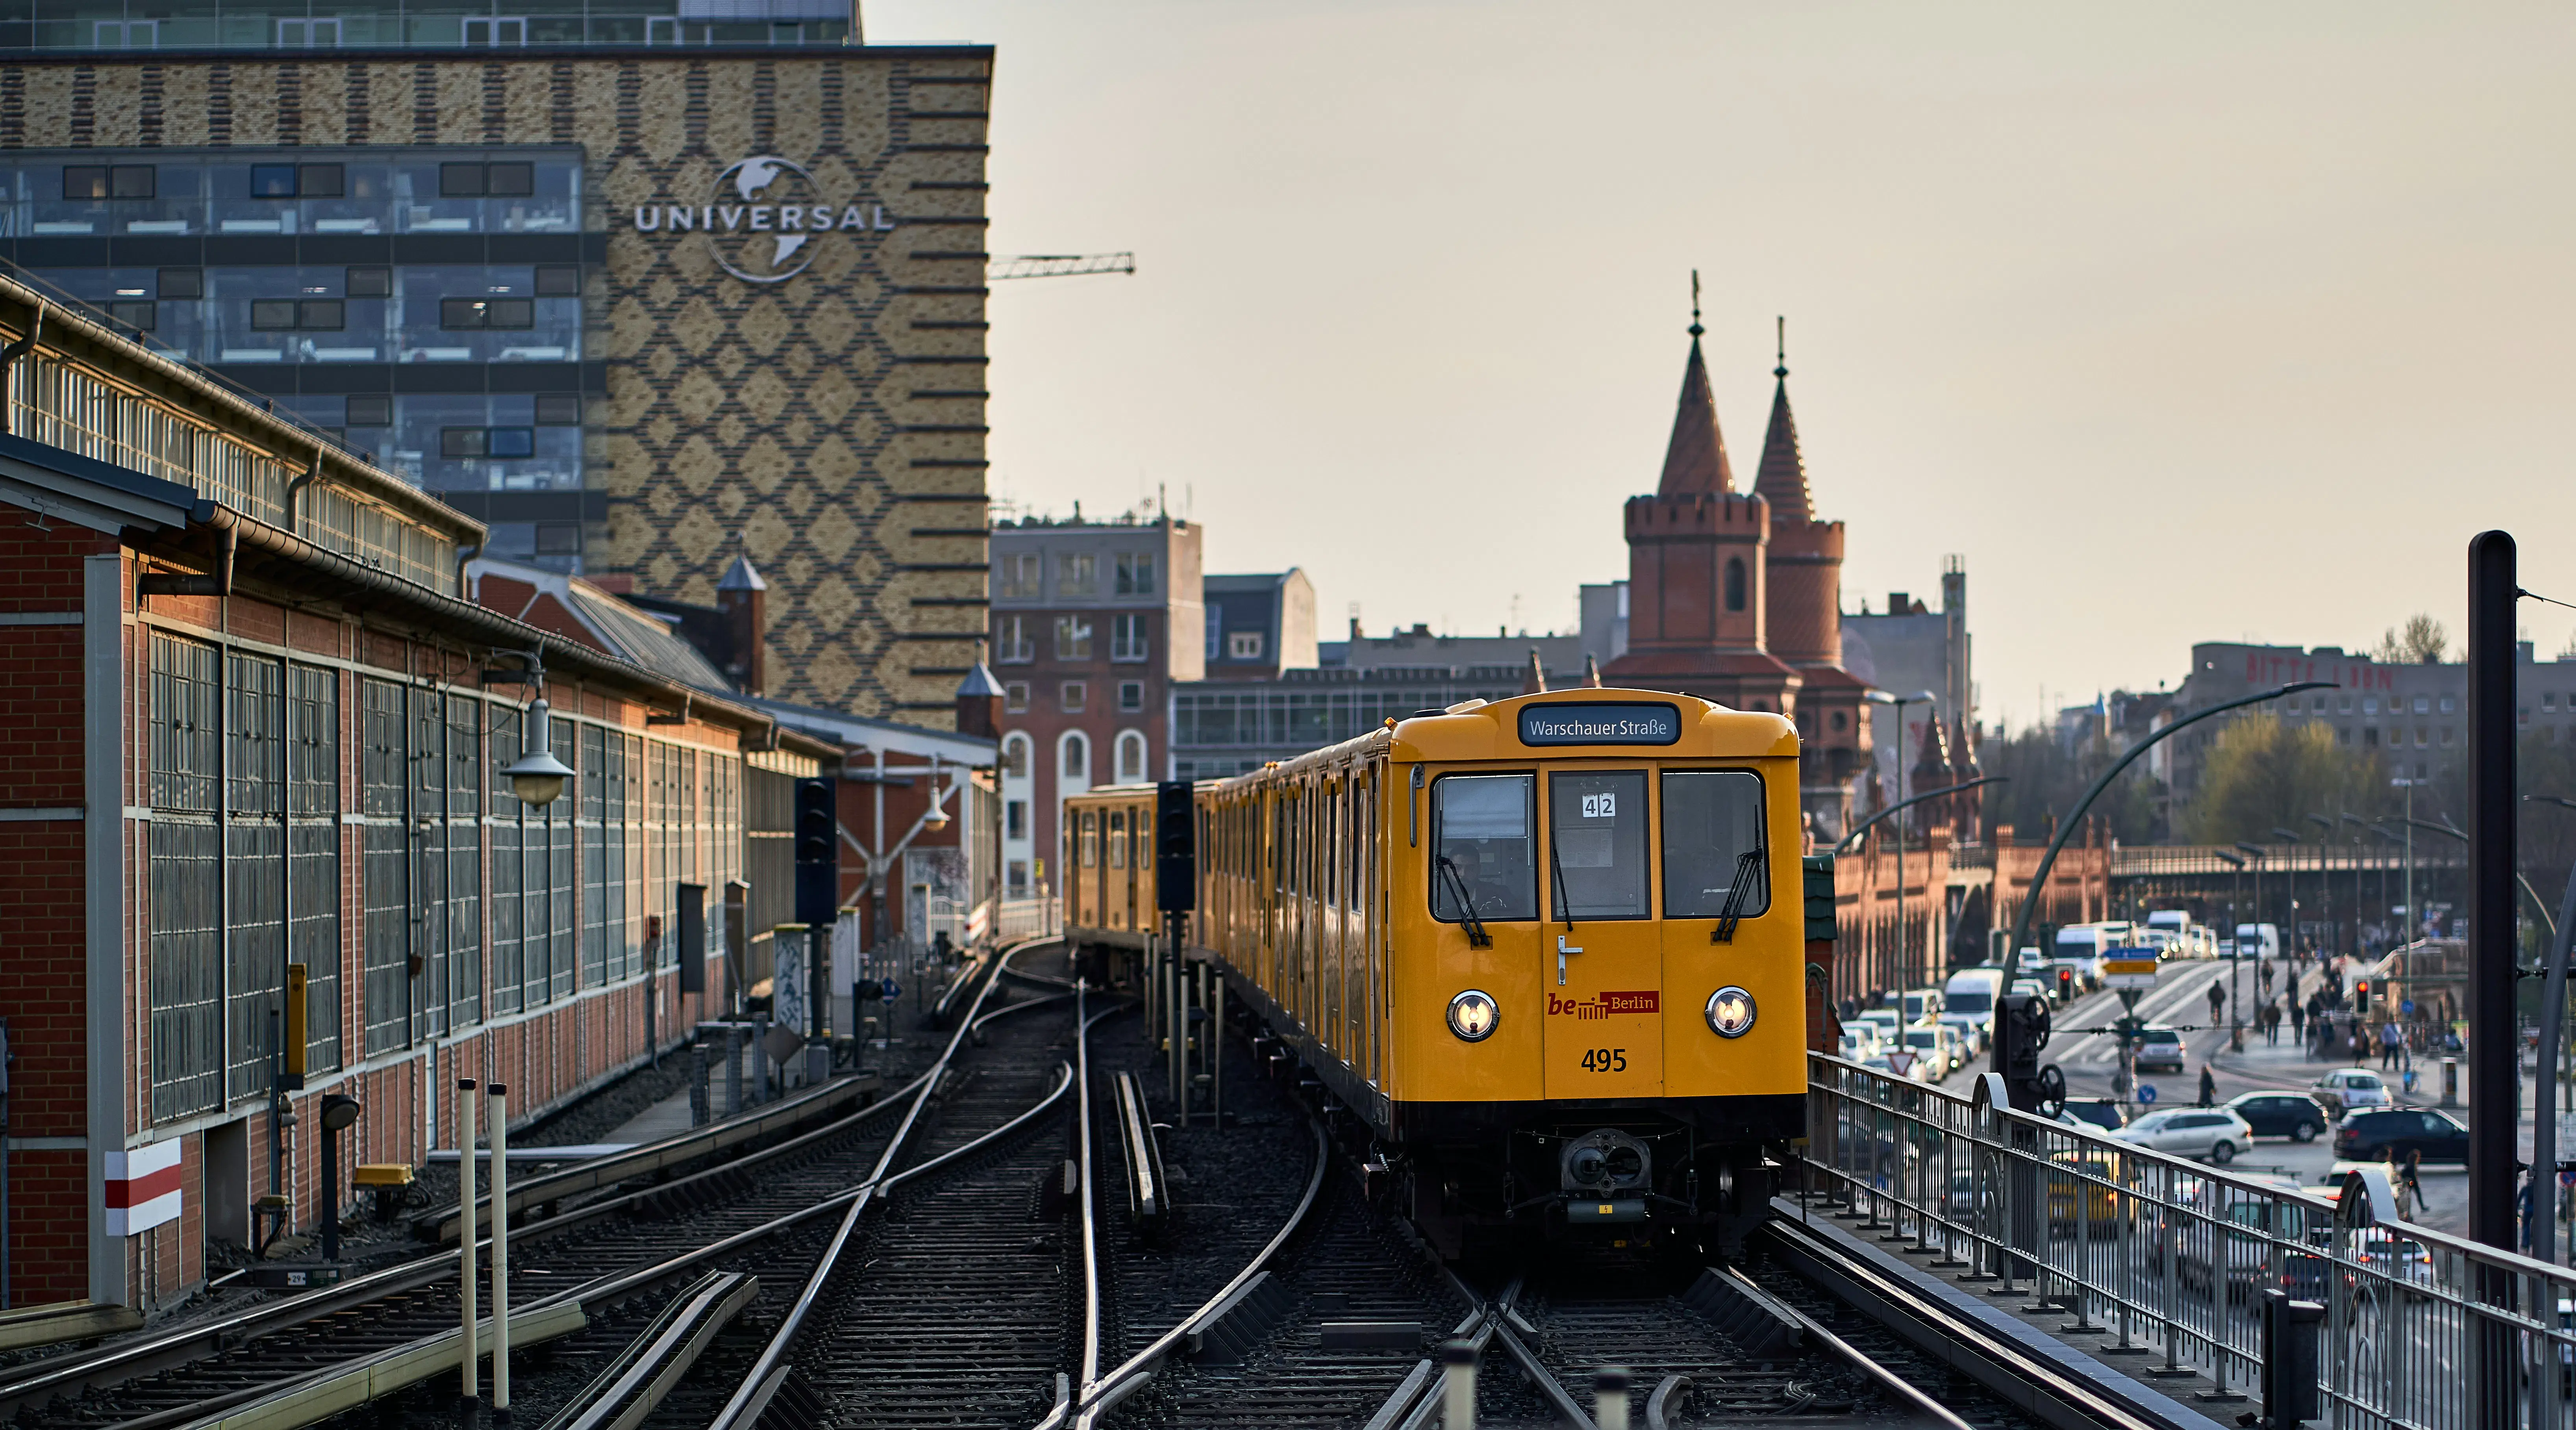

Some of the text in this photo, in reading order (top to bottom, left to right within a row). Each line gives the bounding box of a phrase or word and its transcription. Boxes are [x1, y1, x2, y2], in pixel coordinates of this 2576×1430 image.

[634, 205, 895, 230] UNIVERSAL
[1530, 719, 1667, 736] Warschauer Straße
[1585, 798, 1613, 814] 42
[1548, 992, 1653, 1015] be Berlin
[1581, 1049, 1627, 1072] 495
[292, 1274, 301, 1283] 29
